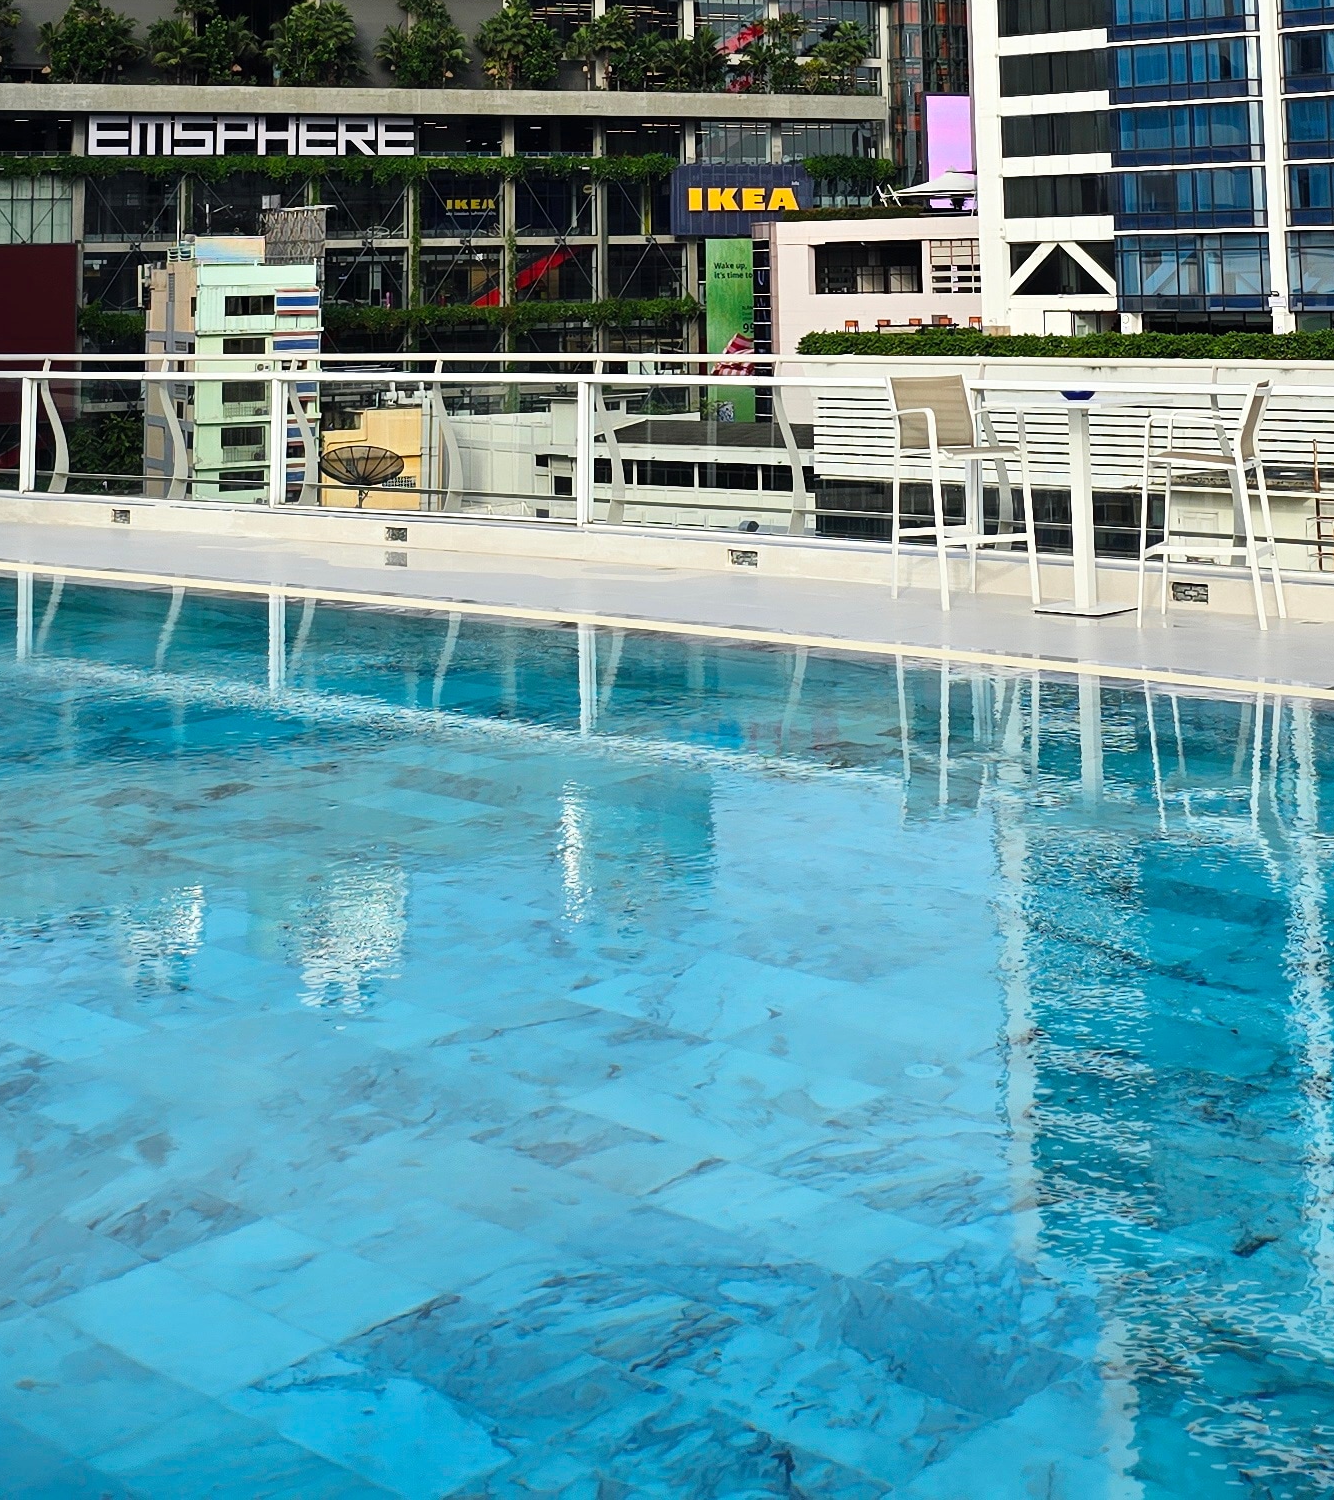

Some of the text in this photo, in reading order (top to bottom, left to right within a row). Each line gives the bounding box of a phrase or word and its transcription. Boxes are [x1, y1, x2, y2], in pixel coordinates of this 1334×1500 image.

[88, 116, 415, 156] EMSPHERE
[446, 199, 496, 210] IKEA
[688, 187, 800, 212] IKEA
